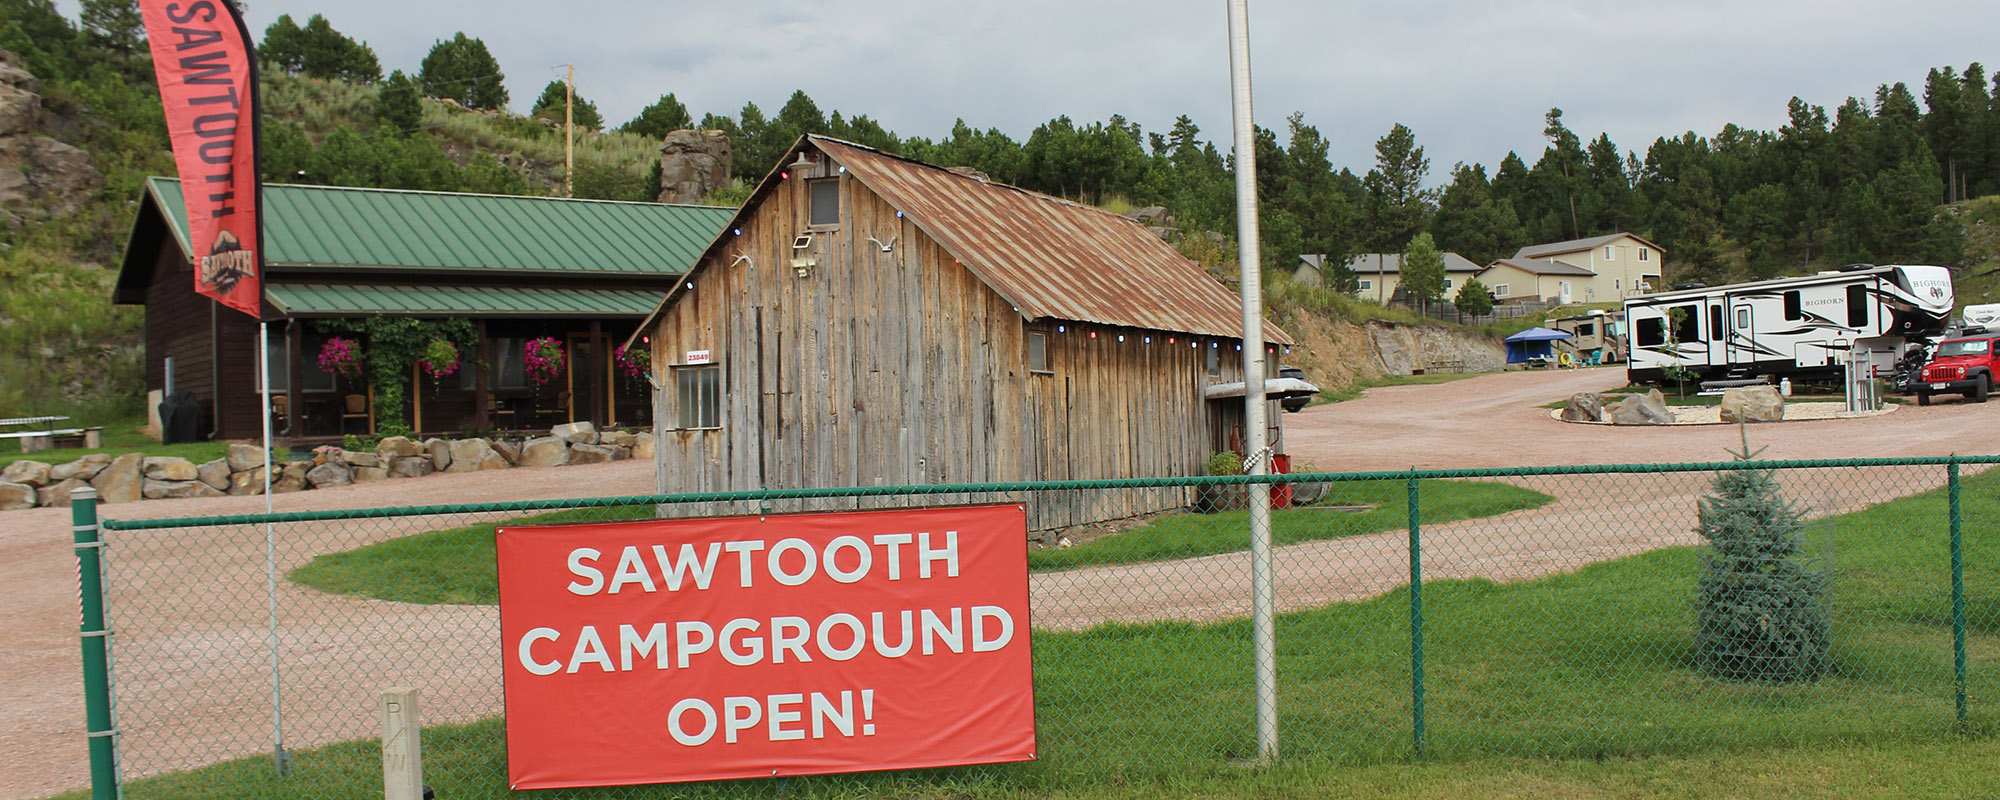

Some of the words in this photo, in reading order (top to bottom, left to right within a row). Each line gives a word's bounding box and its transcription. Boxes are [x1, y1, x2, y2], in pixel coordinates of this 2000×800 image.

[166, 1, 239, 218] SAWTOOTH
[1805, 297, 1844, 306] BIGHORN
[566, 530, 960, 596] SAWTOOTH
[517, 605, 1015, 676] CAMPGROUND
[666, 689, 876, 747] OPEN!
